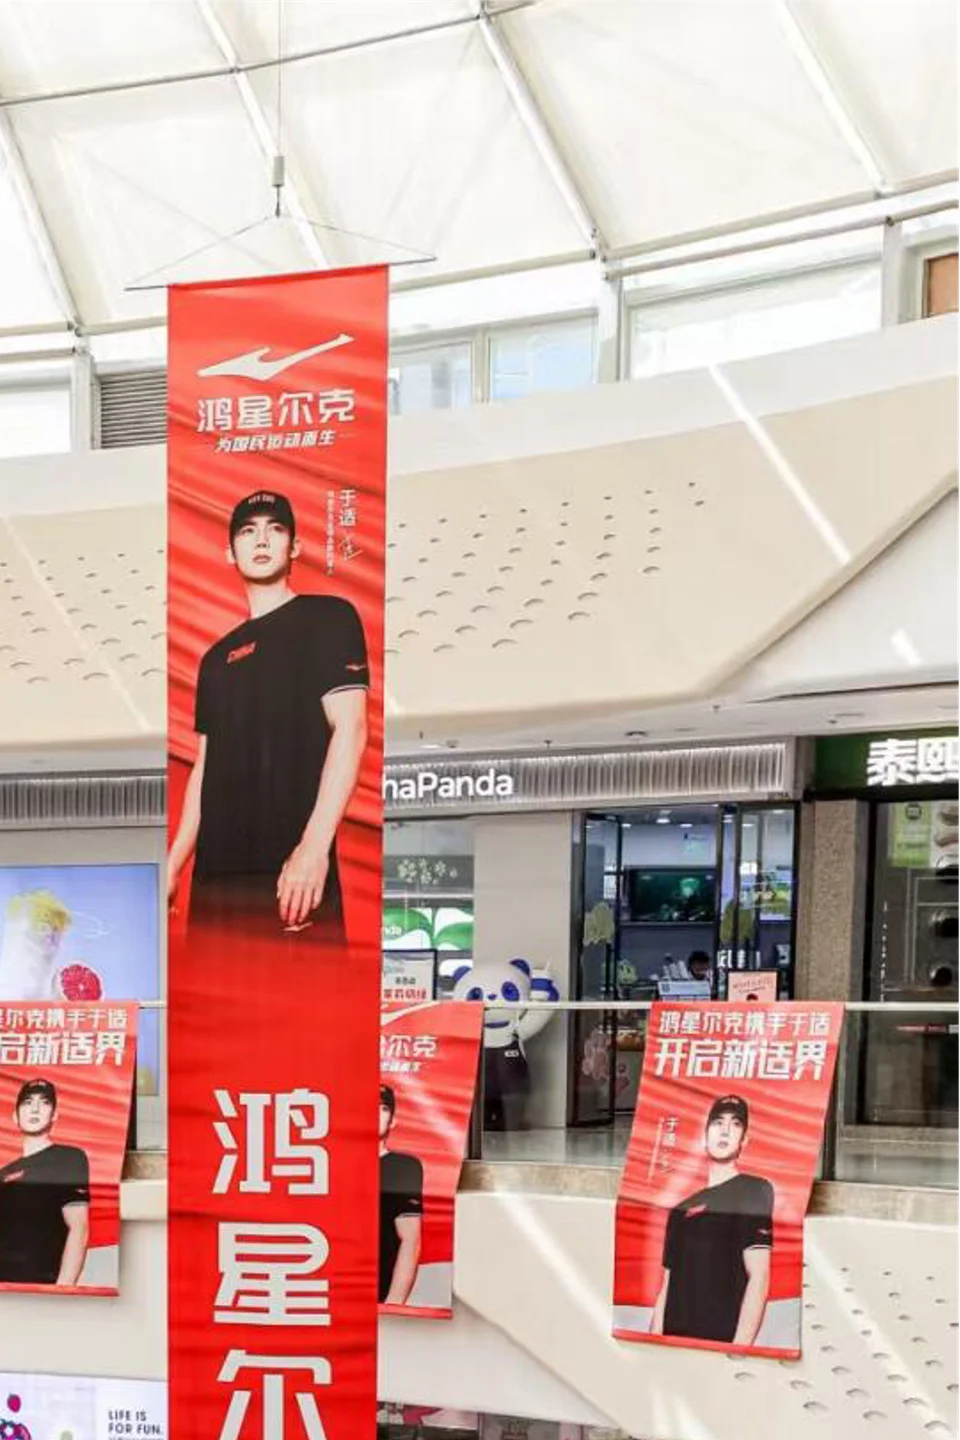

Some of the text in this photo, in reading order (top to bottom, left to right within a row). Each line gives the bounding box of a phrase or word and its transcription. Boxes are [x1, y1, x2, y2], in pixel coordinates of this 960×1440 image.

[196, 389, 355, 432] 鸿星尔克
[383, 769, 514, 799] haPanda
[659, 1011, 831, 1036] 鸿星尔克携手于适
[380, 1034, 437, 1059] 尔克
[108, 1410, 146, 1422] LIFE IS
[108, 1423, 133, 1435] FOR
